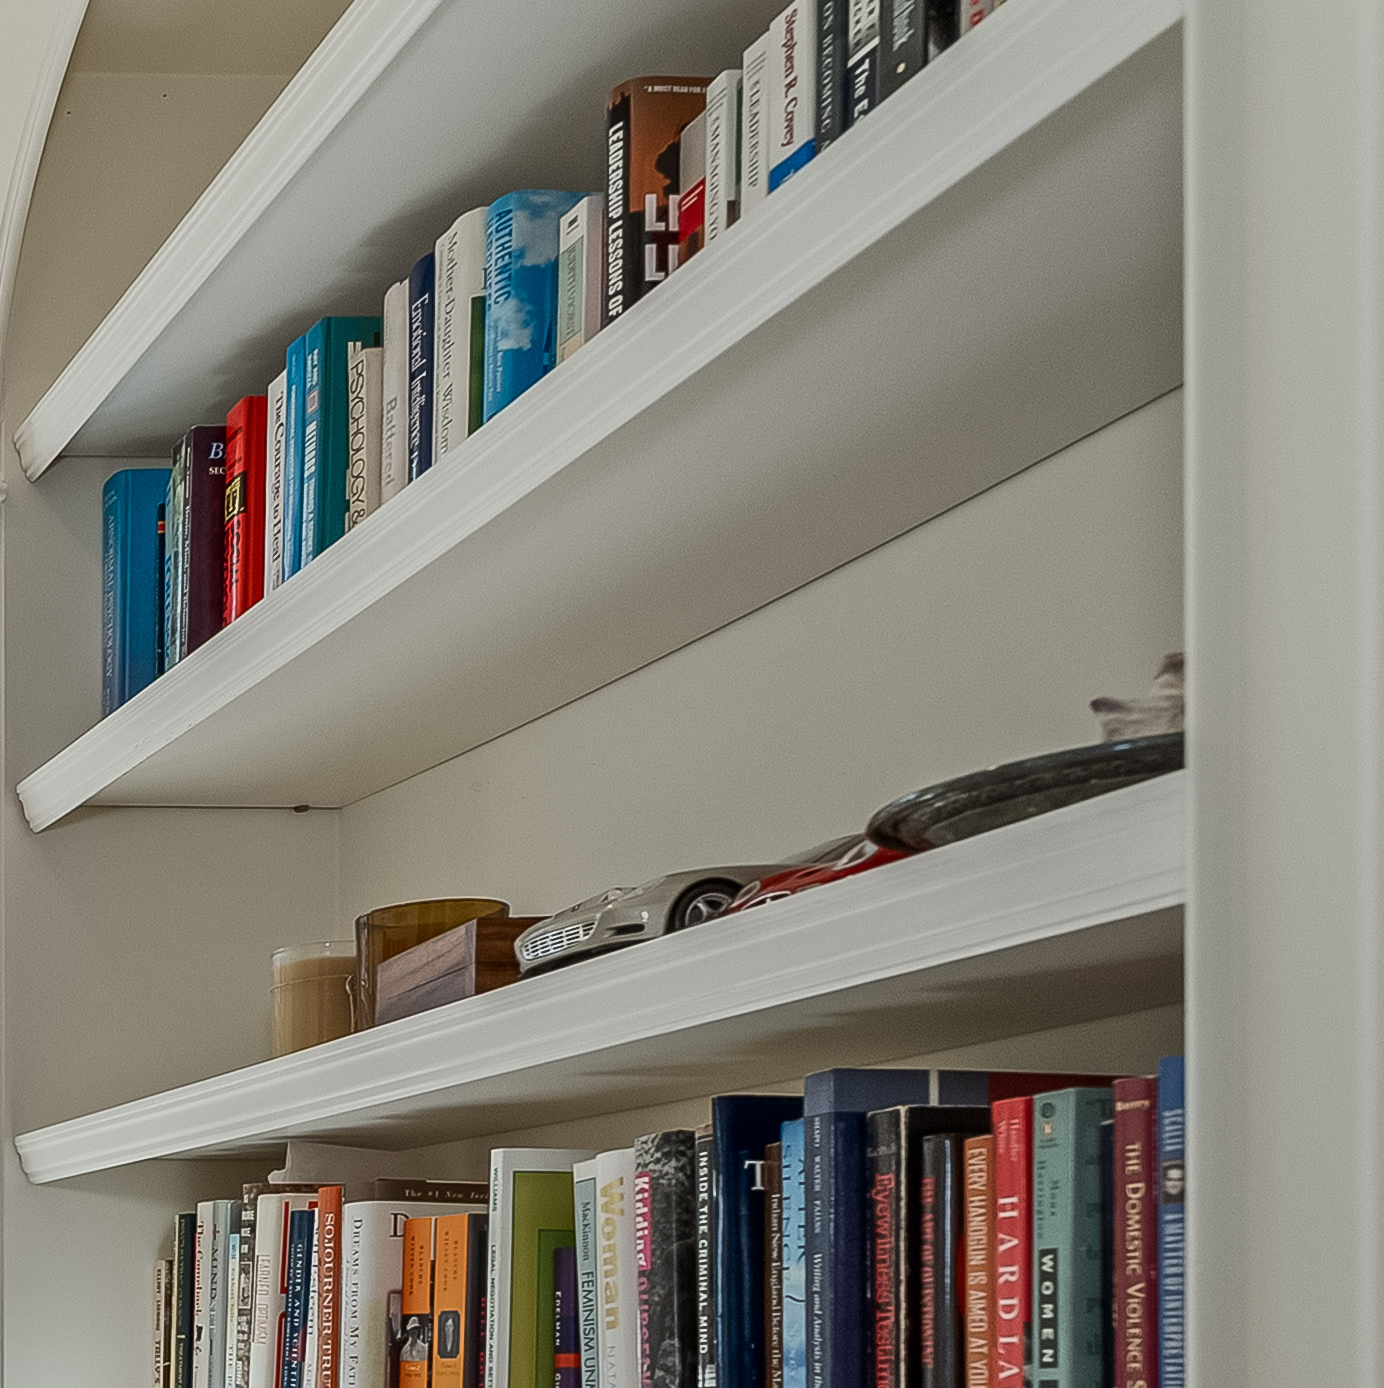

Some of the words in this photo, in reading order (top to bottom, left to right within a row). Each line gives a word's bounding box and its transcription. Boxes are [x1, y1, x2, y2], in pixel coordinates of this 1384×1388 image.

[782, 8, 798, 74] Stephen
[747, 78, 760, 188] LEADERSHIP
[780, 97, 799, 148] Covey
[607, 121, 624, 219] LEADERSHIP
[493, 208, 512, 305] AUTHENTIC
[607, 220, 624, 295] LESSONS
[442, 231, 458, 378] Mother-Daughter
[608, 296, 624, 319] OF
[439, 382, 454, 459] Wisdom
[1115, 1099, 1151, 1111] Berry
[698, 1151, 709, 1200] INSIDE
[968, 1147, 988, 1190] EVERY
[1124, 1142, 1142, 1176] THE
[582, 1200, 592, 1262] MacKinnon
[698, 1203, 709, 1230] THE
[872, 1172, 896, 1303] Eyewitness
[968, 1195, 988, 1265] HANDGUN
[1124, 1182, 1146, 1276] DOMESTIC
[323, 1212, 335, 1335] SOJOURNER
[599, 1176, 626, 1331] Woman
[698, 1233, 709, 1314] CRIMINAL
[969, 1272, 988, 1284] IS
[581, 1271, 596, 1353] FEMINISM
[699, 1316, 710, 1354] MIND
[969, 1290, 988, 1333] AIMED
[1040, 1253, 1056, 1364] WOMEN
[1124, 1282, 1147, 1376] VIOLENCE
[969, 1338, 988, 1355] AT
